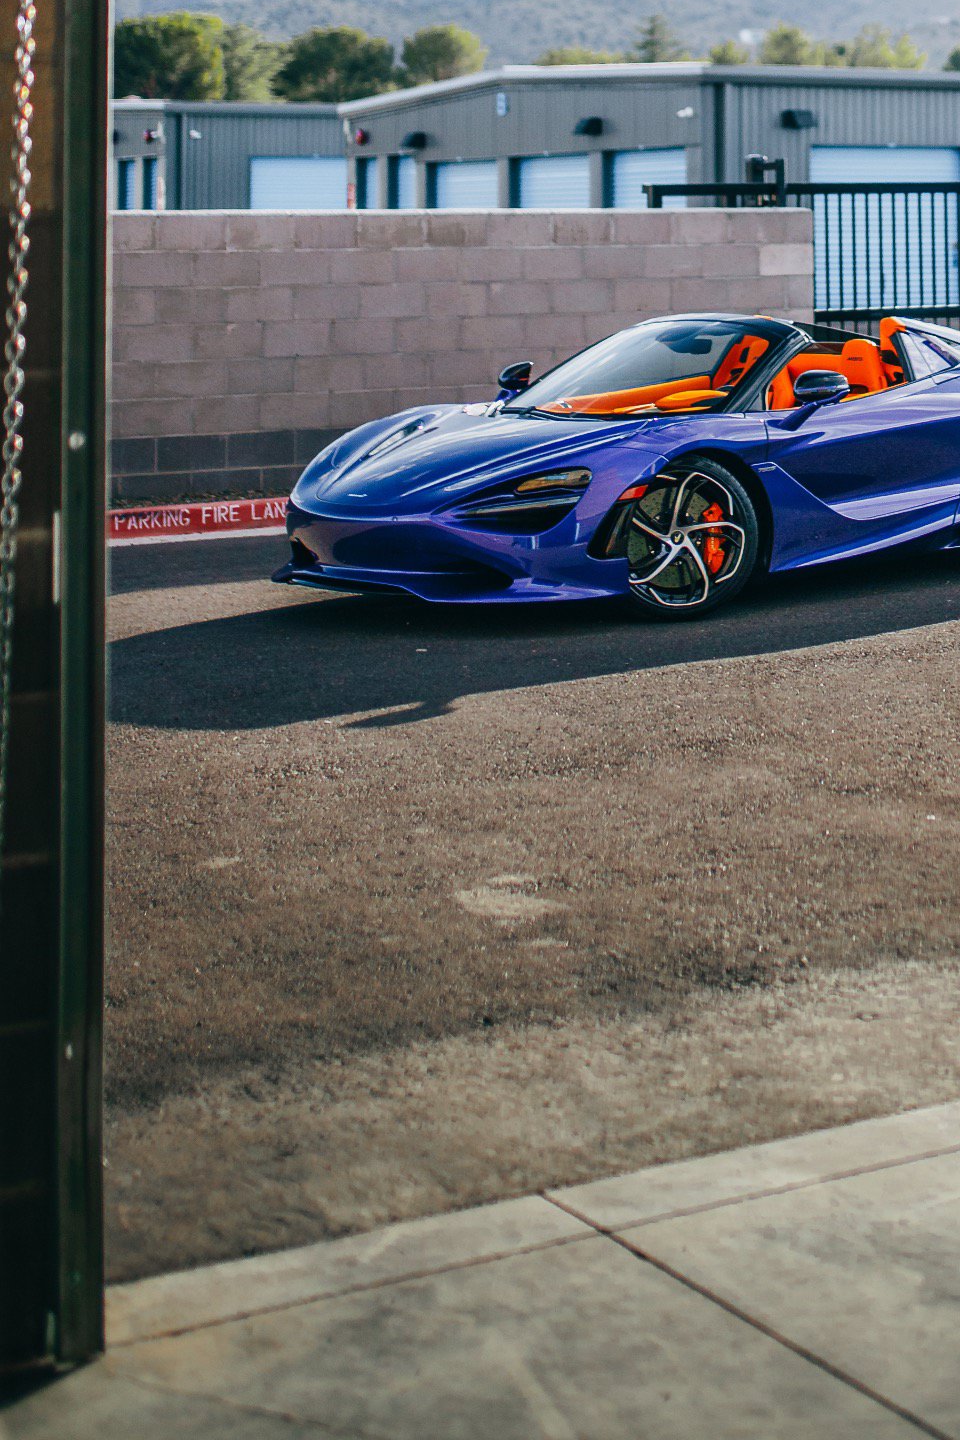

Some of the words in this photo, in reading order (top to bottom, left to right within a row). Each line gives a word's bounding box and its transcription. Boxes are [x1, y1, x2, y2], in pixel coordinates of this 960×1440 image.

[114, 508, 191, 531] PARKING
[201, 504, 241, 524] FIRE
[251, 500, 289, 521] LAN
